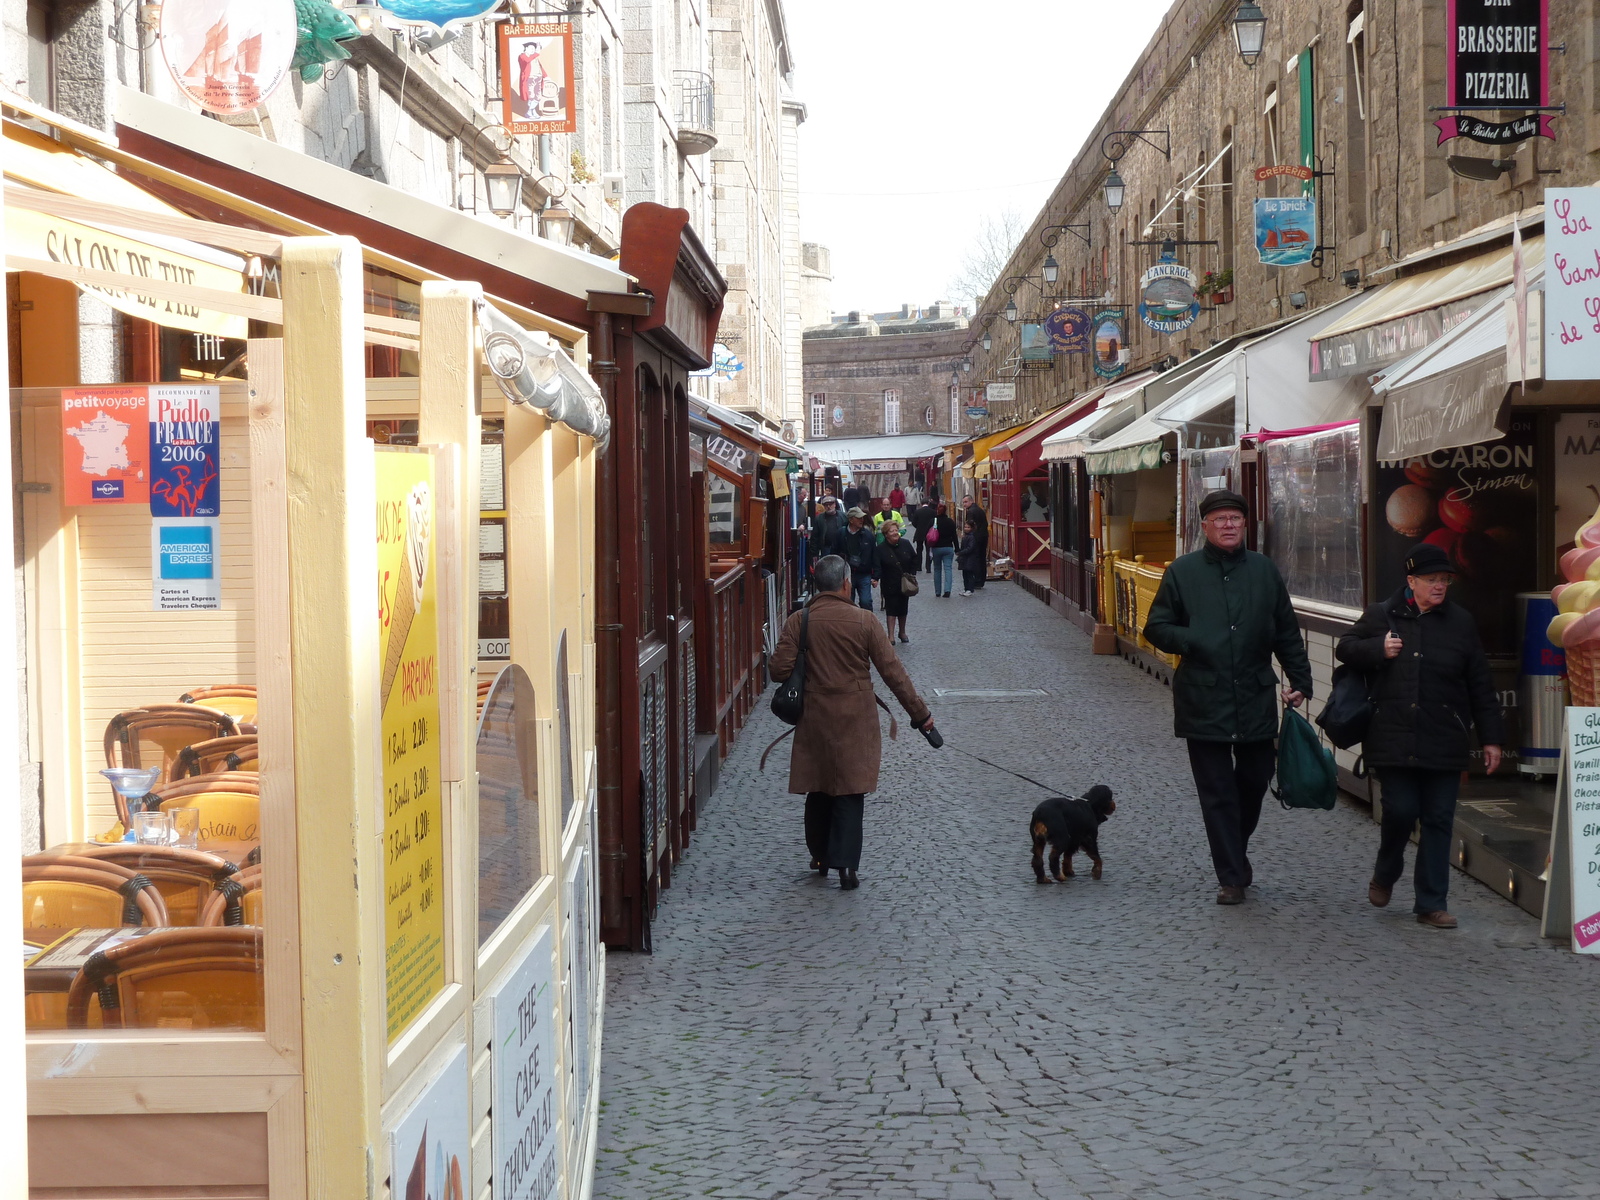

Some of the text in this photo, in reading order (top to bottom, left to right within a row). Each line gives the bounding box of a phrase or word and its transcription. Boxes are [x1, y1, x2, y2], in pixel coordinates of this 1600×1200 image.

[504, 23, 568, 35] BAR-BRASSERIE
[1457, 25, 1538, 53] BRASSERIE
[1465, 72, 1530, 99] PIZZERIA
[528, 122, 539, 133] De
[539, 122, 550, 132] La
[1458, 118, 1537, 140] Le Bistrot de Cathy
[1258, 165, 1308, 180] CREPERIE
[1264, 200, 1308, 213] Le Brick
[1553, 198, 1593, 236] La
[1146, 265, 1191, 280] L'ANCRAGE
[1143, 314, 1195, 332] RESTAURANT
[1560, 320, 1583, 345] de
[157, 388, 197, 396] RECOMMANDÉ
[173, 398, 182, 406] Le
[64, 395, 146, 411] petitvoyage
[157, 398, 211, 423] Pudlo
[155, 421, 213, 444] FRANCE
[161, 445, 206, 462] 2006
[1446, 460, 1534, 502] Simon
[160, 543, 210, 554] AMERICAN
[169, 553, 213, 564] EXPRESS
[401, 653, 435, 708] PARFUMS!
[517, 982, 538, 1048] THE
[515, 1042, 541, 1119] CAFE
[502, 1086, 553, 1200] CHOCOLAT
